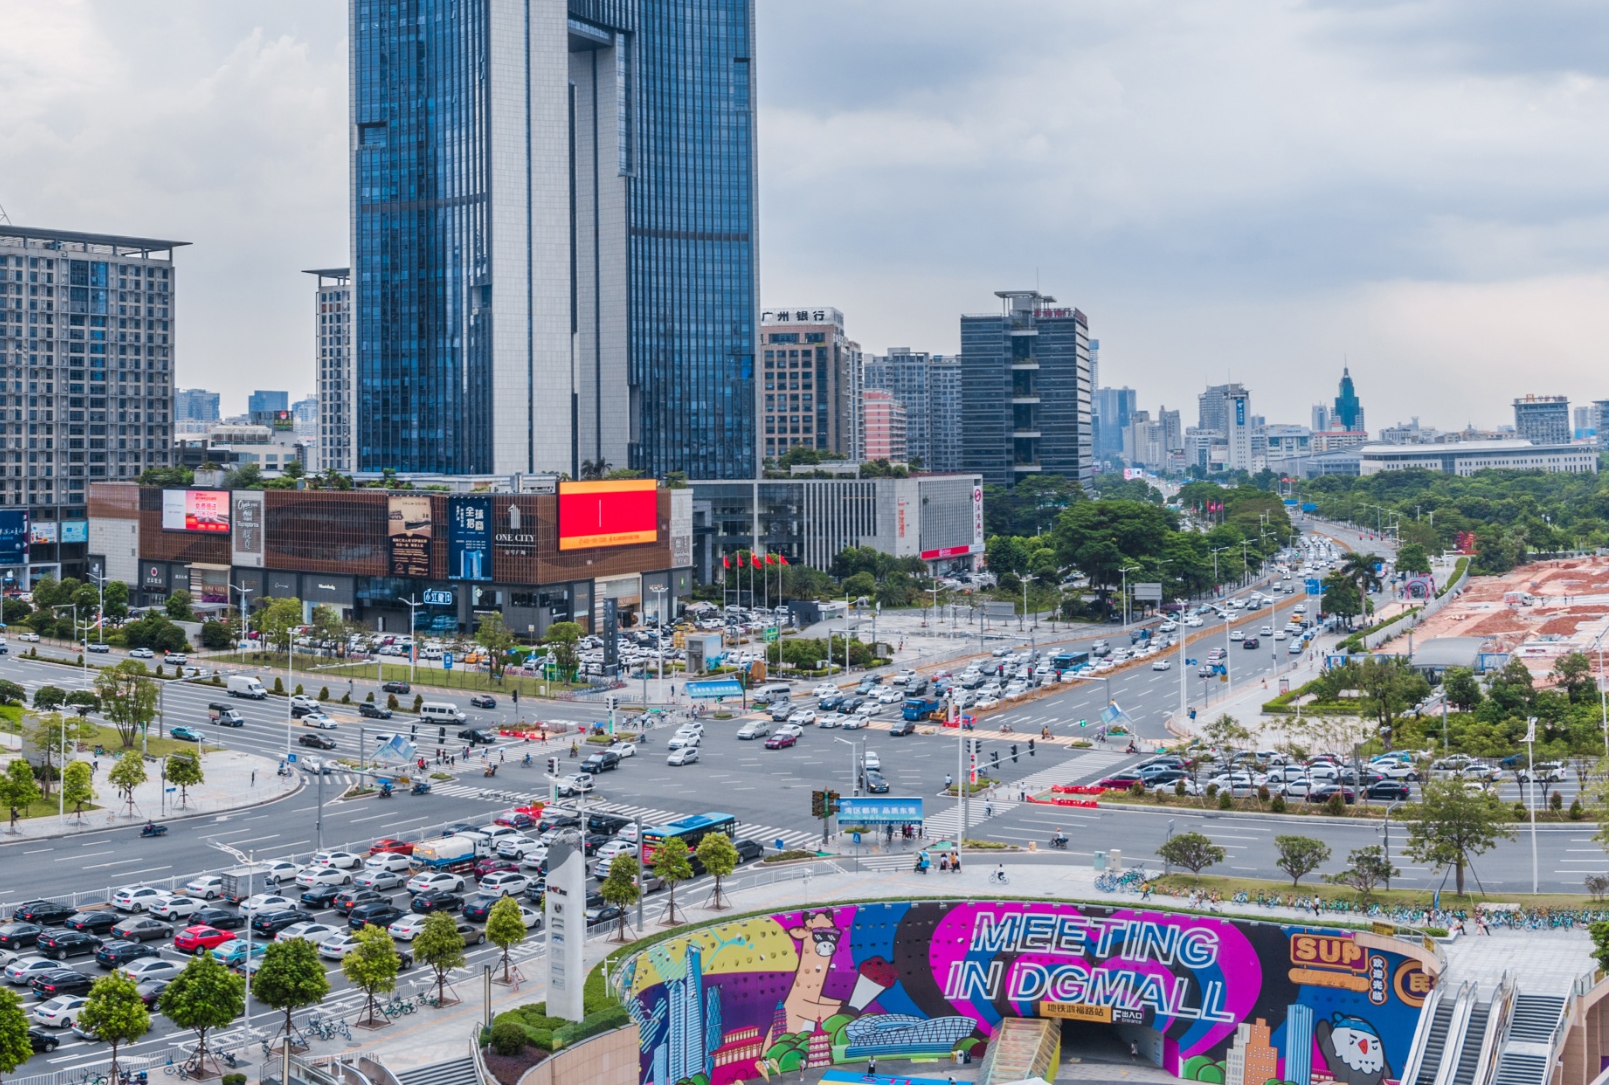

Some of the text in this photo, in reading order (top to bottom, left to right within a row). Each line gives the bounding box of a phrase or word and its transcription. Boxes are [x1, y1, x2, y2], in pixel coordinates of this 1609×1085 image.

[761, 310, 825, 322] 广州银行
[495, 534, 535, 542] ONE CITY
[969, 911, 1219, 969] MEETING
[1296, 937, 1362, 964] SUP
[1372, 958, 1384, 1002] 欢迎光临
[944, 961, 1235, 1023] IN DGMALL
[1047, 1003, 1104, 1017] 地铁鸿福路站
[1112, 1009, 1121, 1022] F
[1121, 1011, 1143, 1019] 出入口
